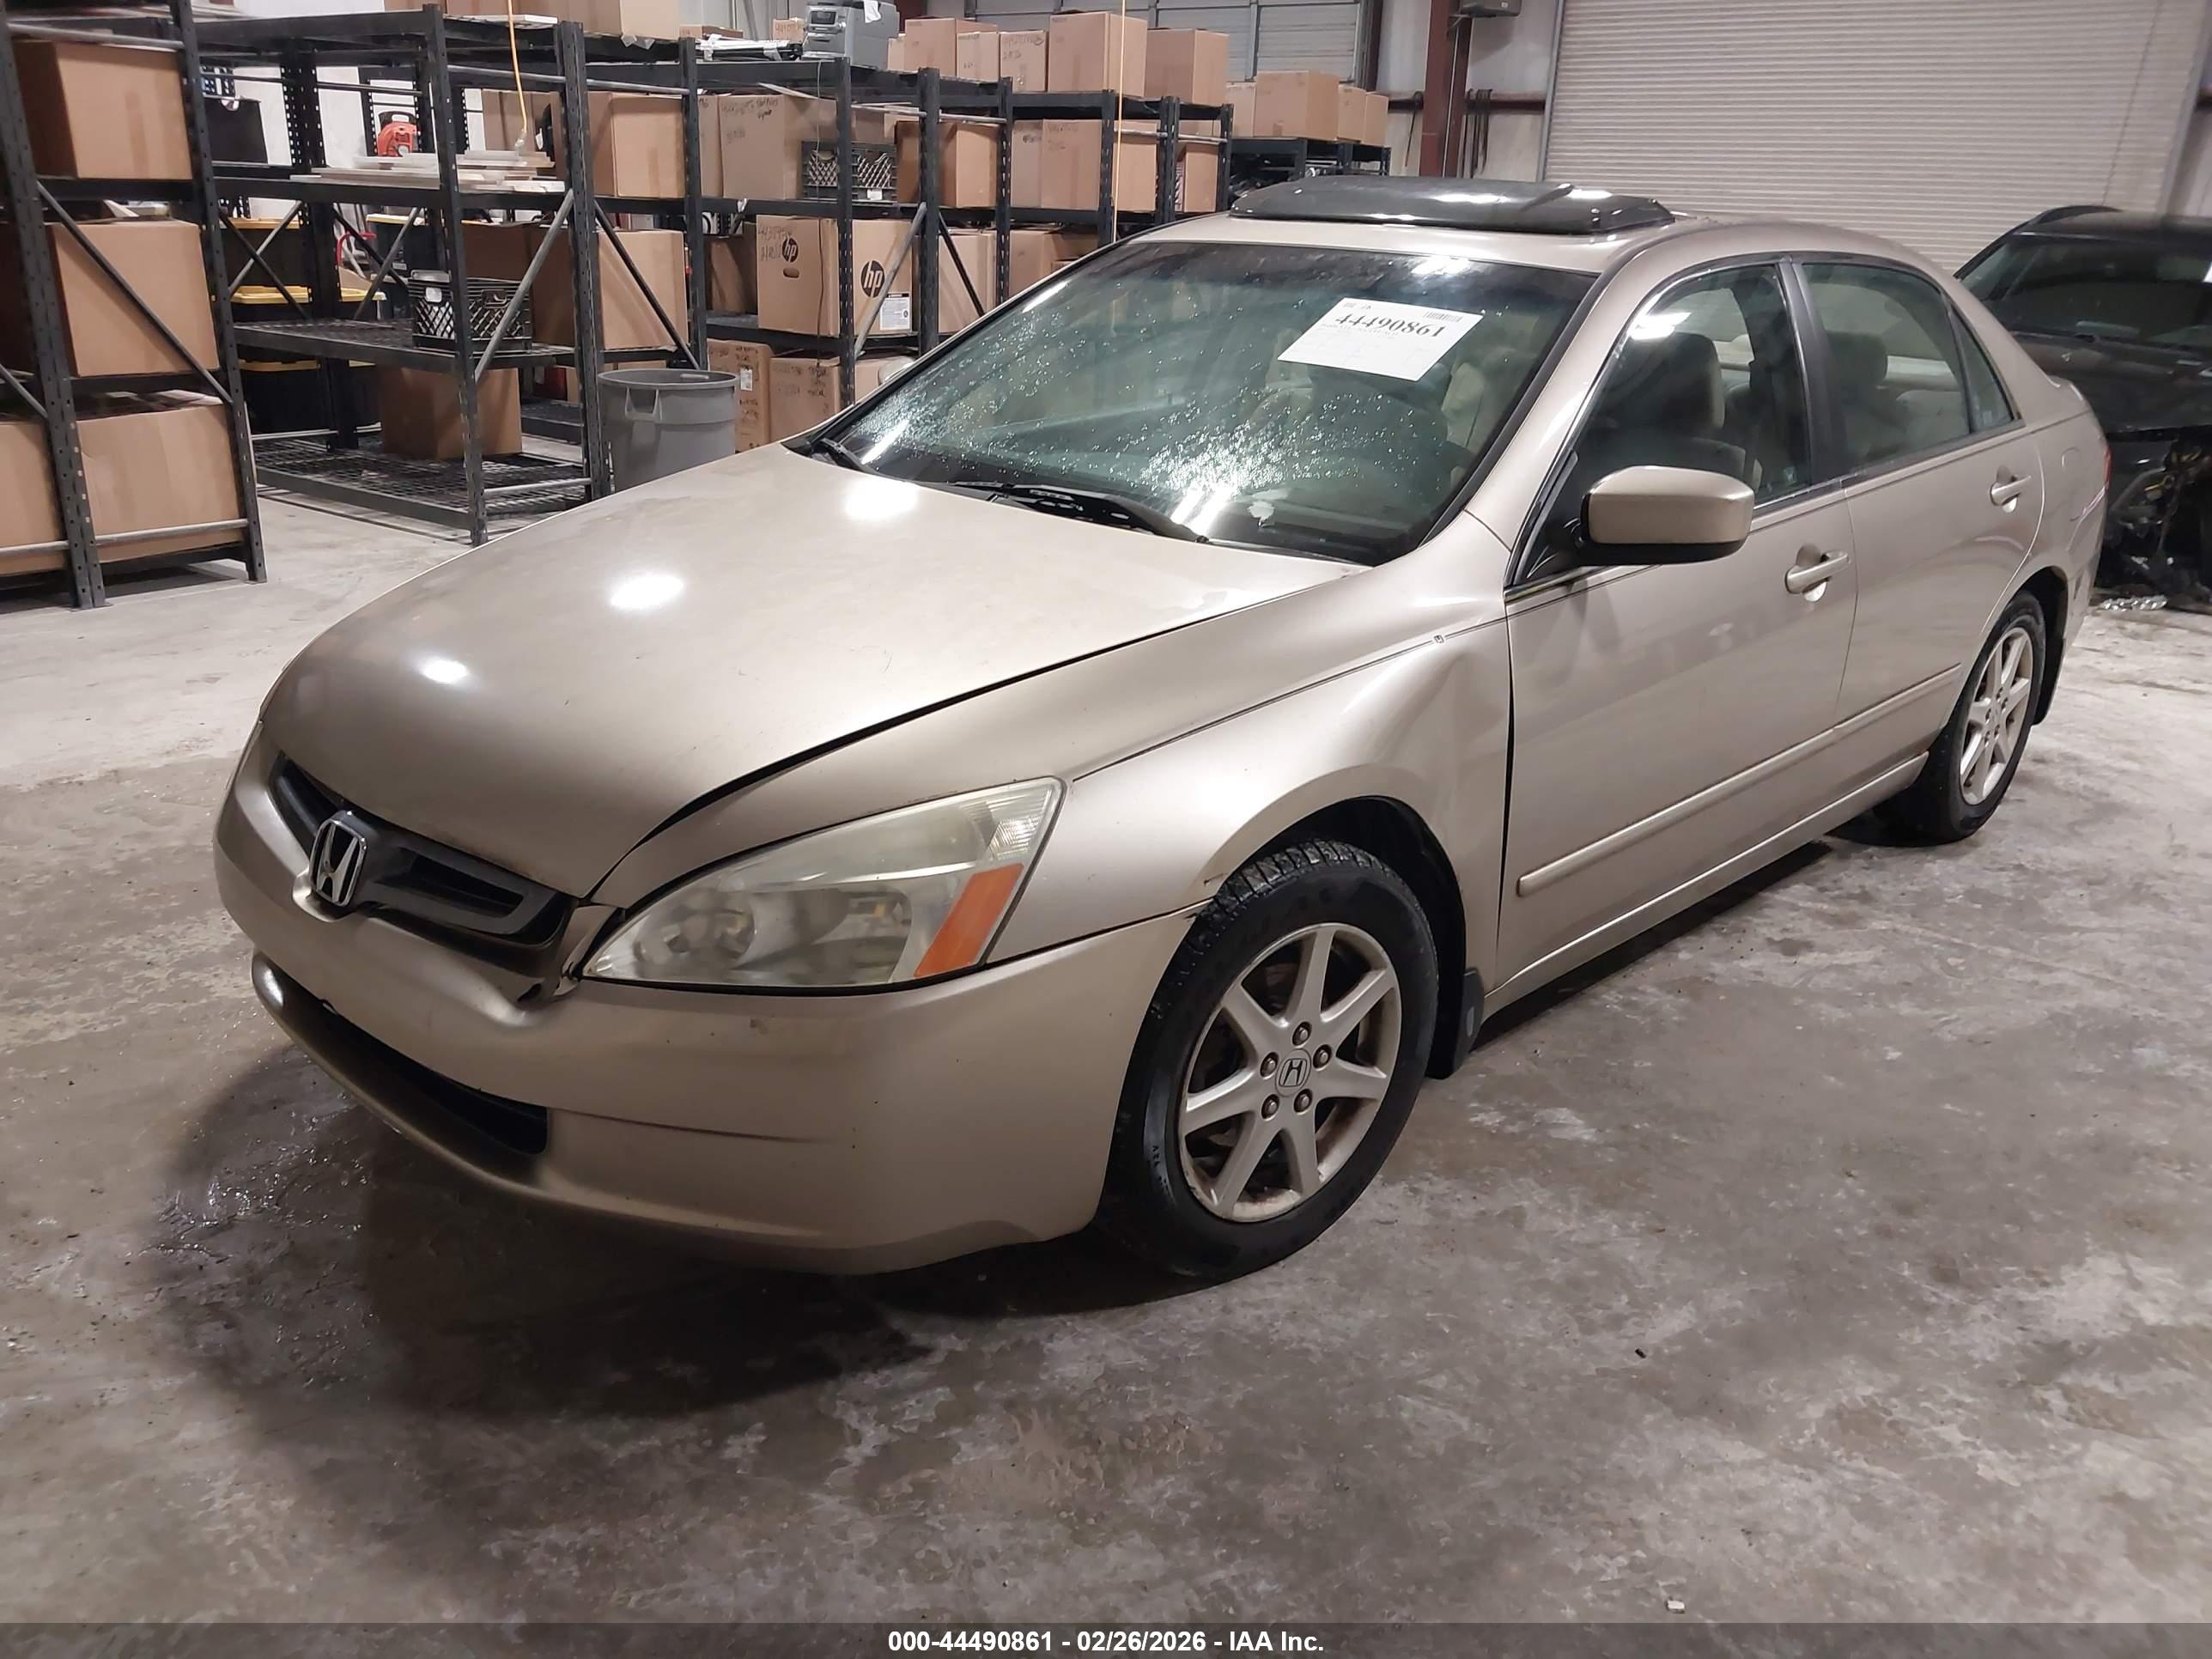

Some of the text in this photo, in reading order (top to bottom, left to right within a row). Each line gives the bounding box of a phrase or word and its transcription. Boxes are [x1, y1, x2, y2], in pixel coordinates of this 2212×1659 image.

[782, 235, 799, 263] hp
[861, 259, 885, 298] hp
[1334, 313, 1446, 337] 44490861
